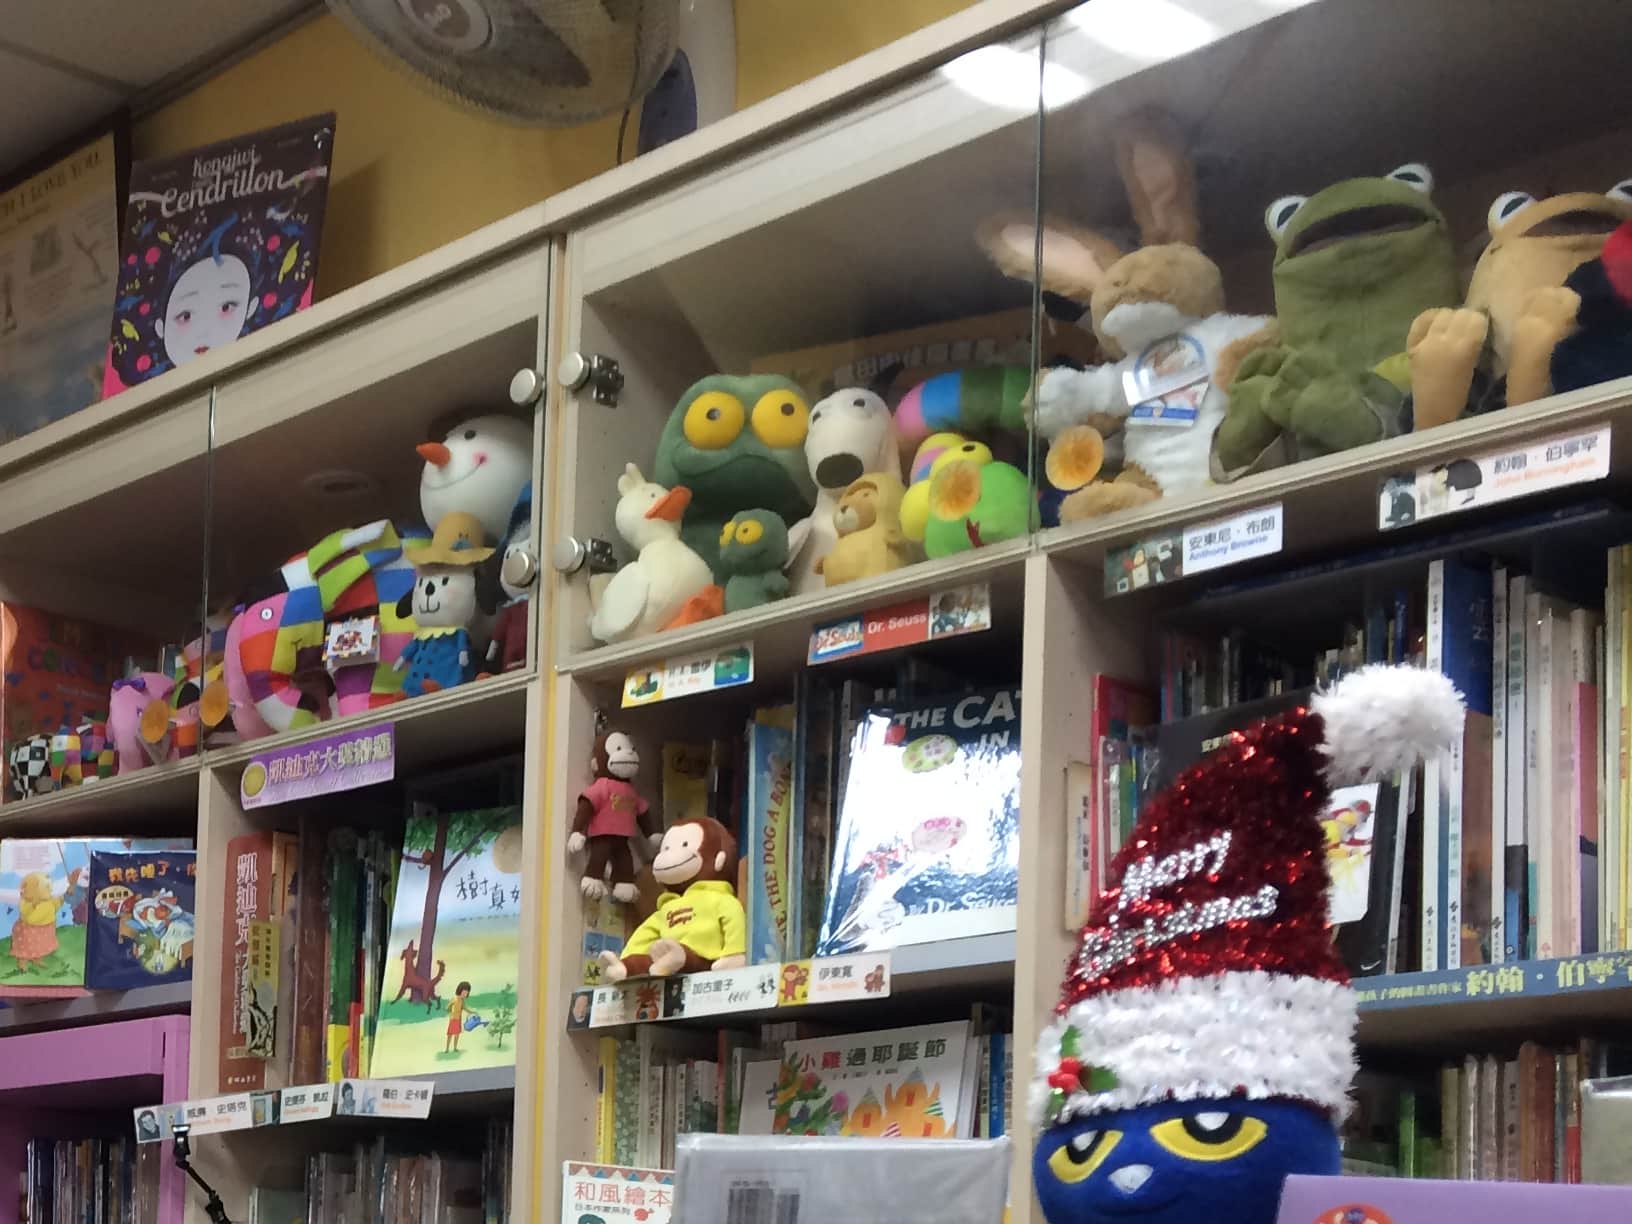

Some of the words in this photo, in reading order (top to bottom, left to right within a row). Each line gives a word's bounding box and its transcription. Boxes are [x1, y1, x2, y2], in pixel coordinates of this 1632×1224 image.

[160, 163, 288, 218] Cendrillon
[867, 618, 885, 636] Dr.
[887, 612, 928, 631] Seuss
[893, 707, 947, 730] THE
[952, 690, 1022, 729] CA
[979, 730, 1011, 751] IN
[767, 809, 780, 823] A
[763, 826, 776, 864] DOG
[574, 1182, 673, 1208] 和風繪本
